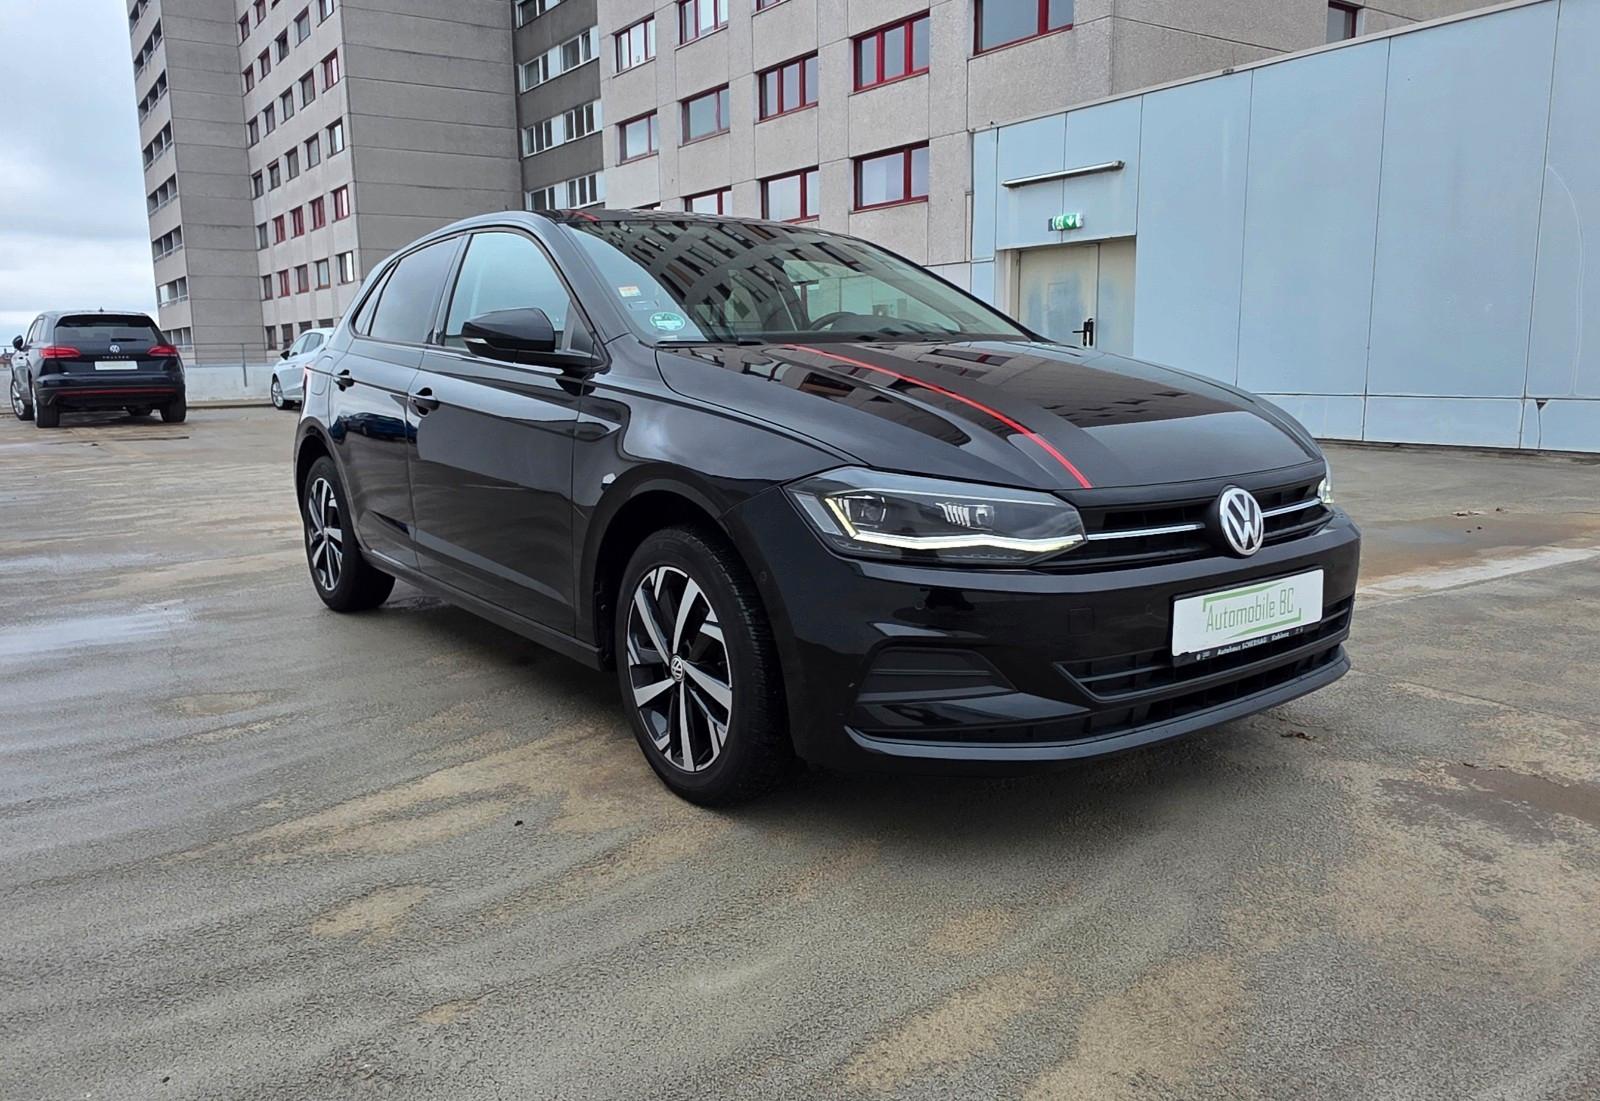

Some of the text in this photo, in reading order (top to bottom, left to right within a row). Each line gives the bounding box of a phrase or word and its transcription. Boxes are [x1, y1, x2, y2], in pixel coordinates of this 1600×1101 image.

[1220, 488, 1264, 555] VW
[1205, 587, 1294, 633] Automobile BC
